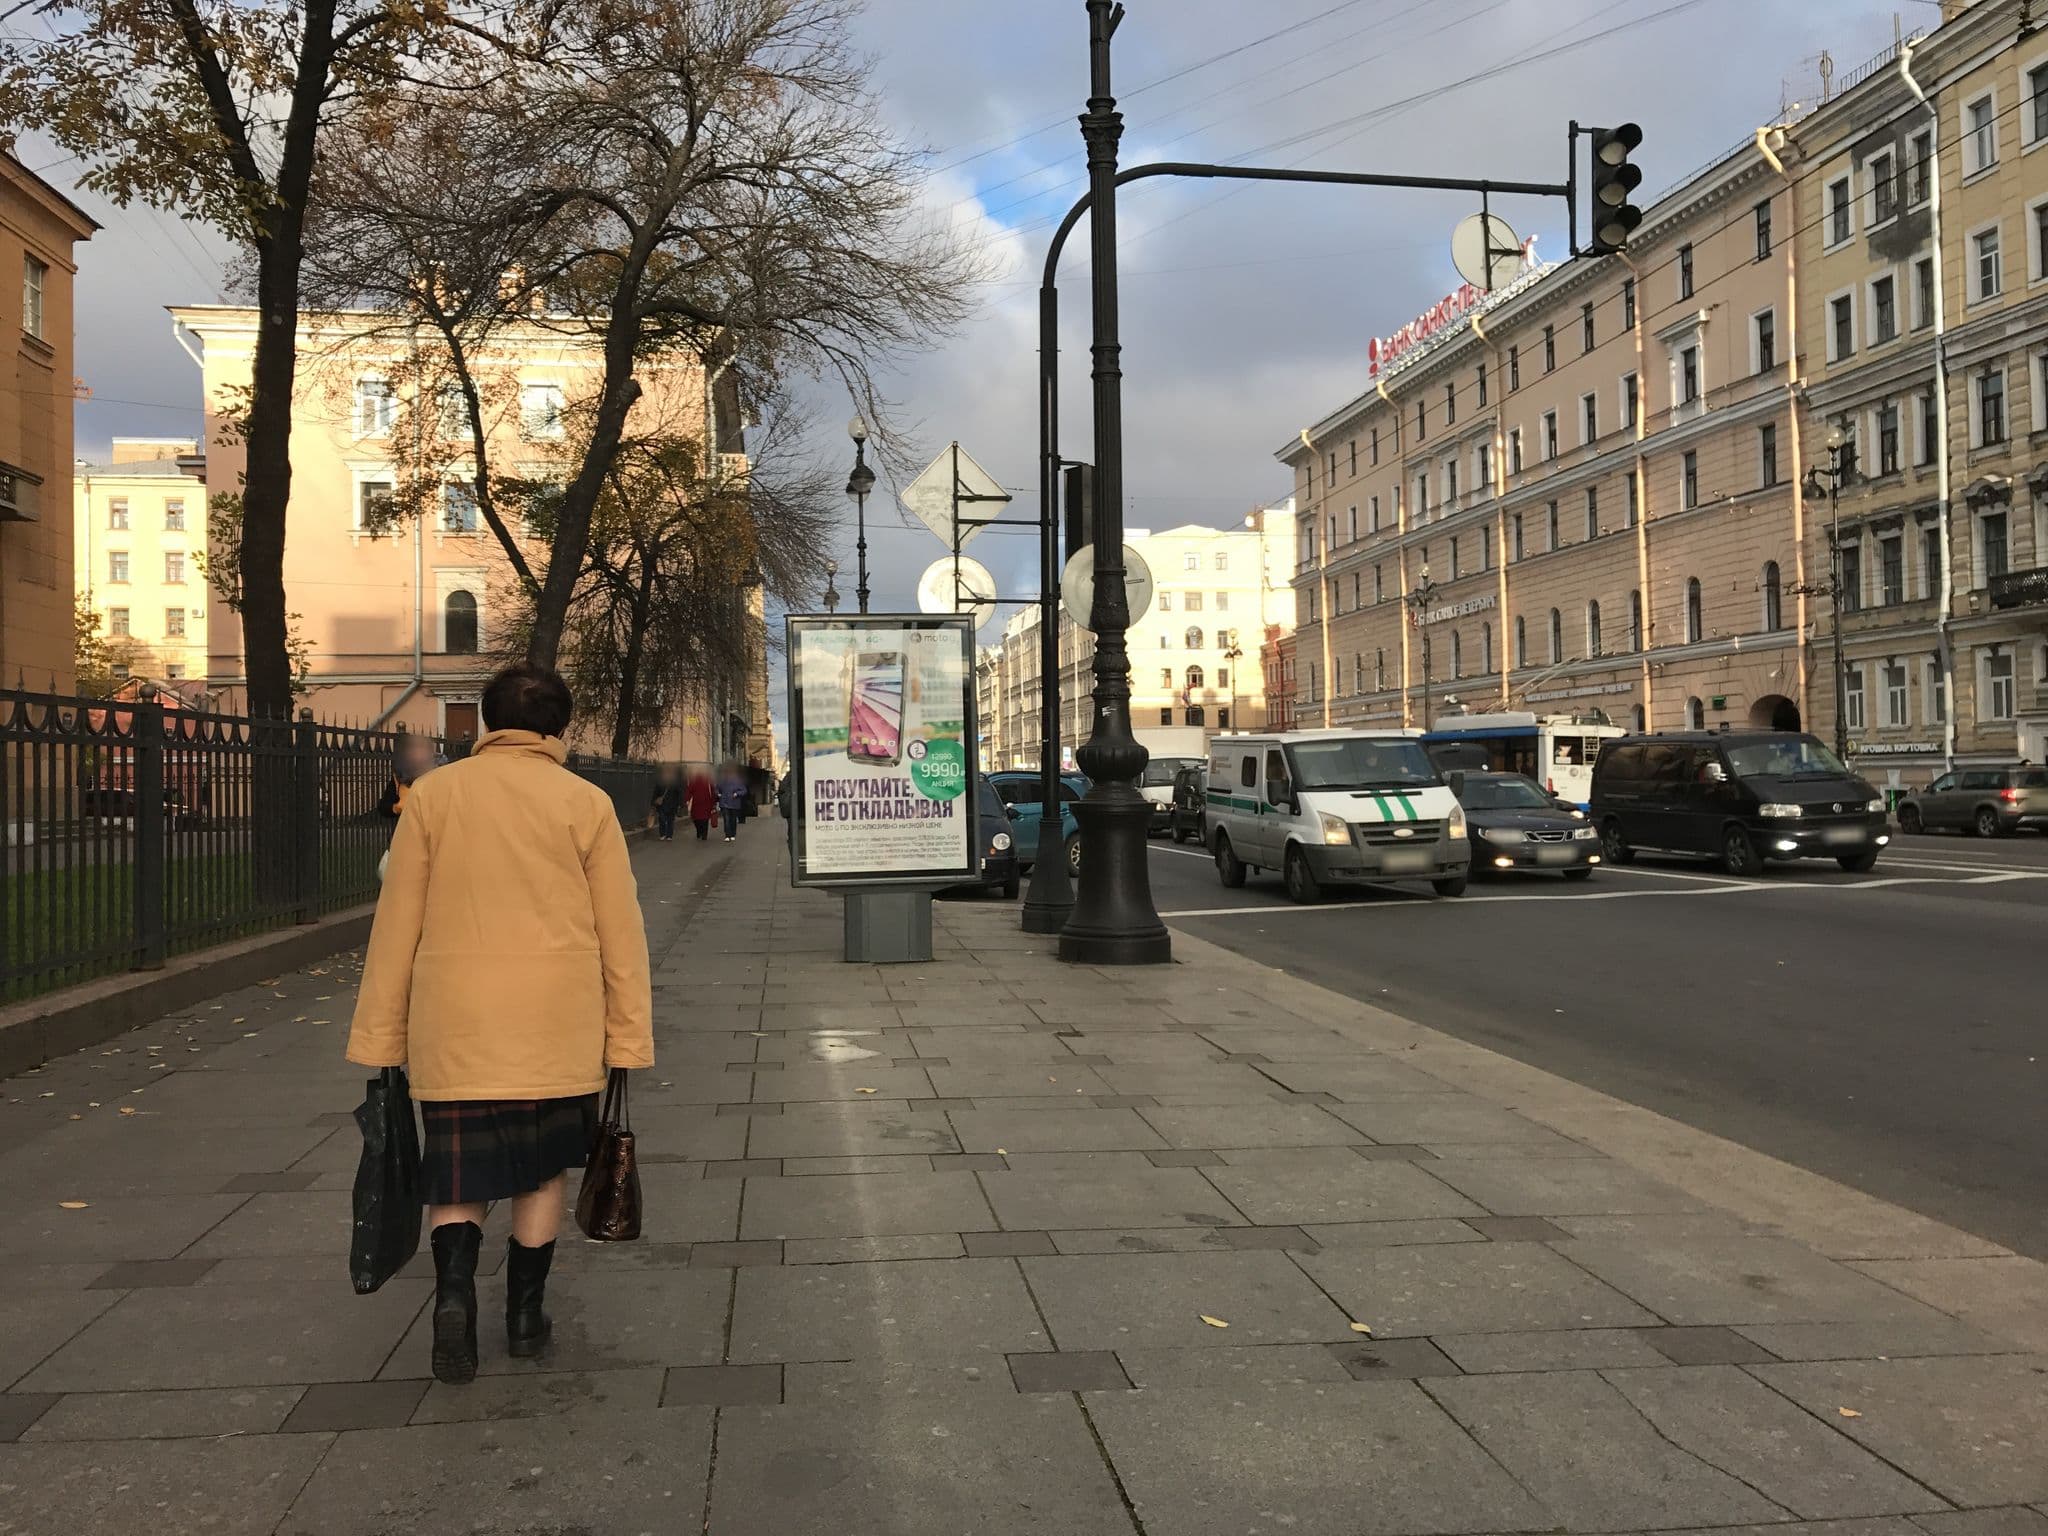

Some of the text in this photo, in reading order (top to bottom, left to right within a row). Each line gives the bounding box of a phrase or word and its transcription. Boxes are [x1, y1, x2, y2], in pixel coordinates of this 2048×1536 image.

[1382, 327, 1414, 363] БАНК
[920, 762, 960, 778] 9990
[814, 777, 914, 799] ПОКУПАЙТЕ,
[815, 799, 953, 821] НЕ ОТКЛАДЫВАЯ
